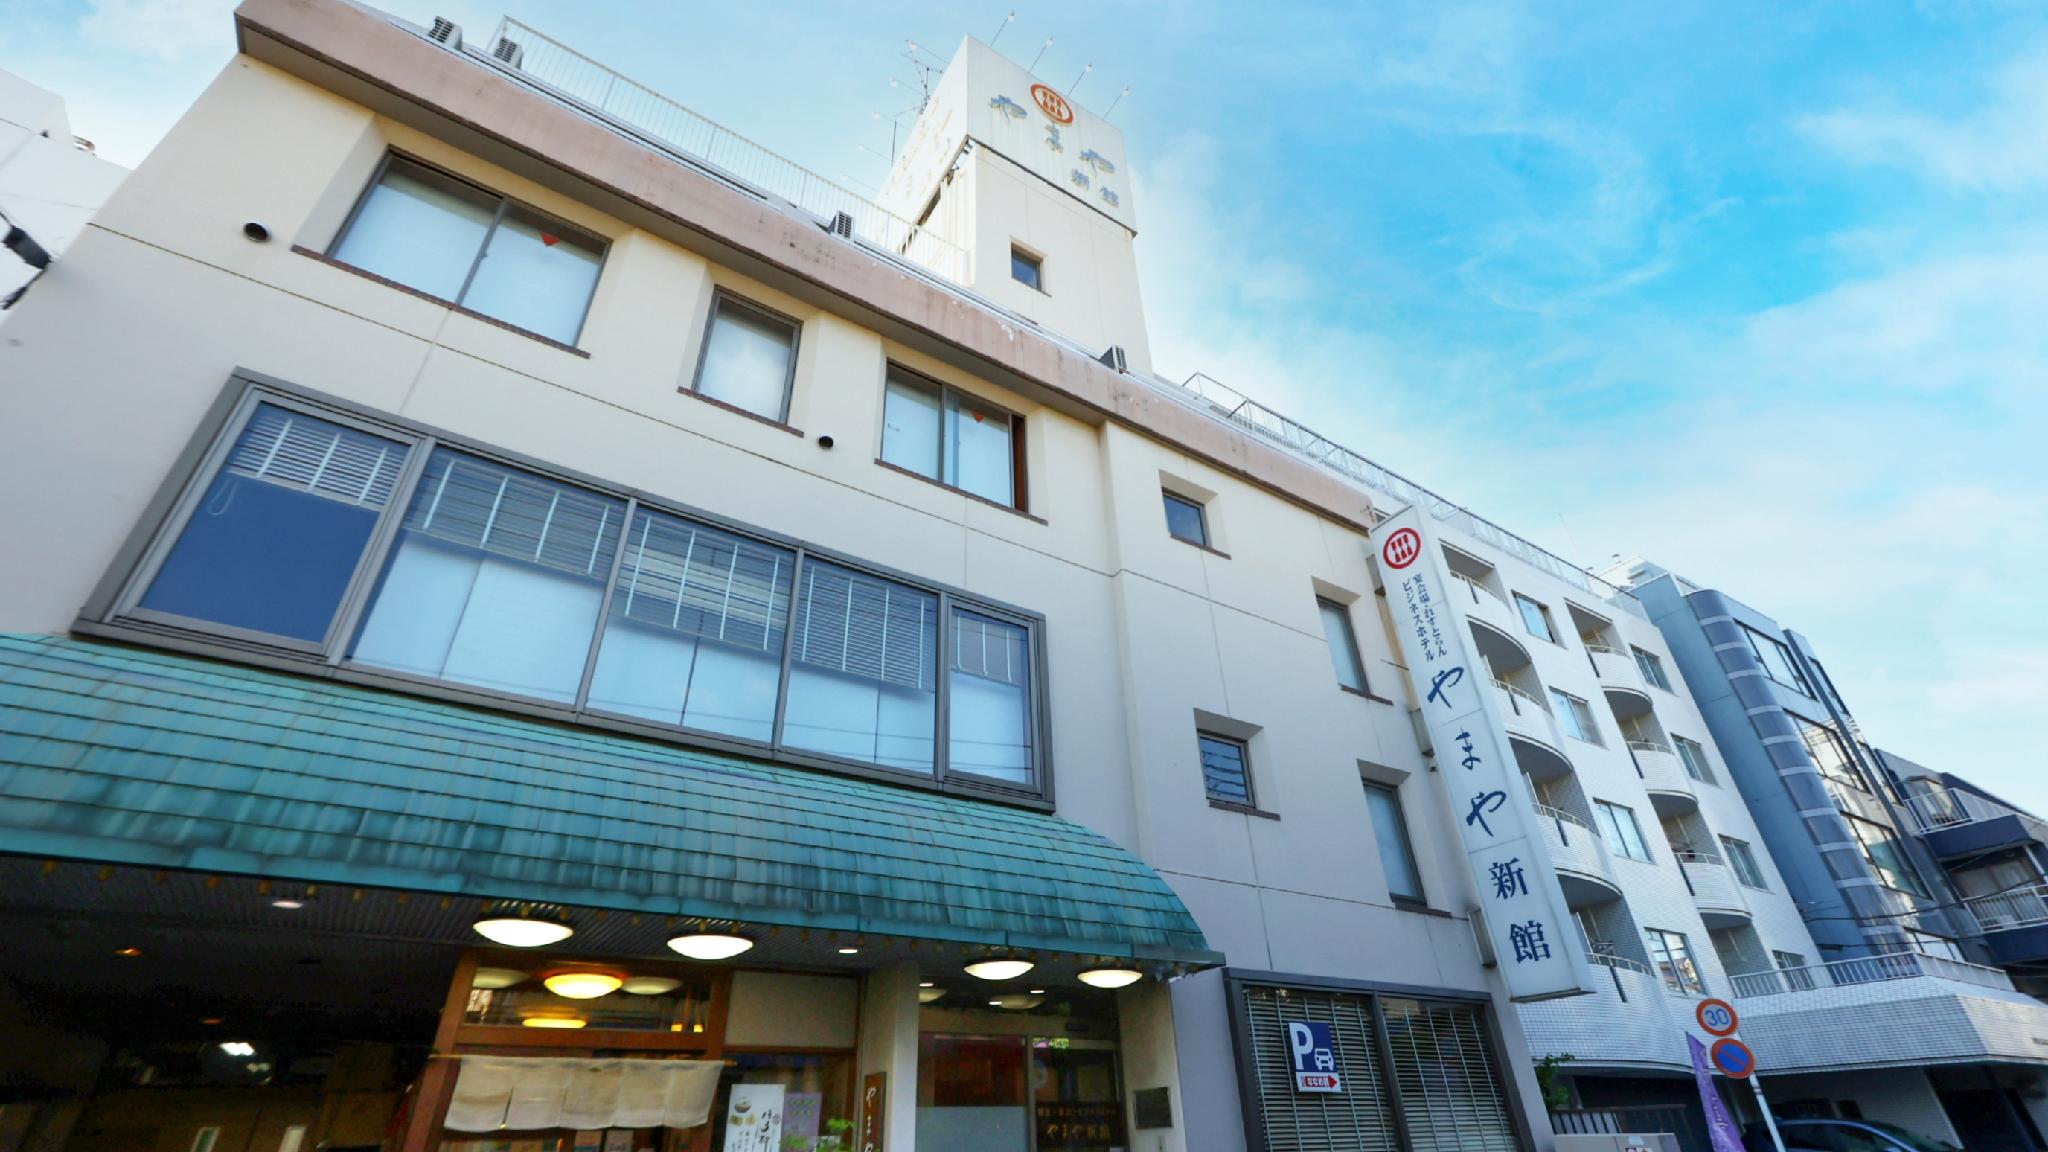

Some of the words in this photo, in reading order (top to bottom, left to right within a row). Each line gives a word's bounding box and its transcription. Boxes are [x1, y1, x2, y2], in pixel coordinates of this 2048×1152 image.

[1402, 579, 1435, 662] ビジネスホテル
[1705, 1008, 1729, 1026] 30
[1289, 1022, 1314, 1070] P
